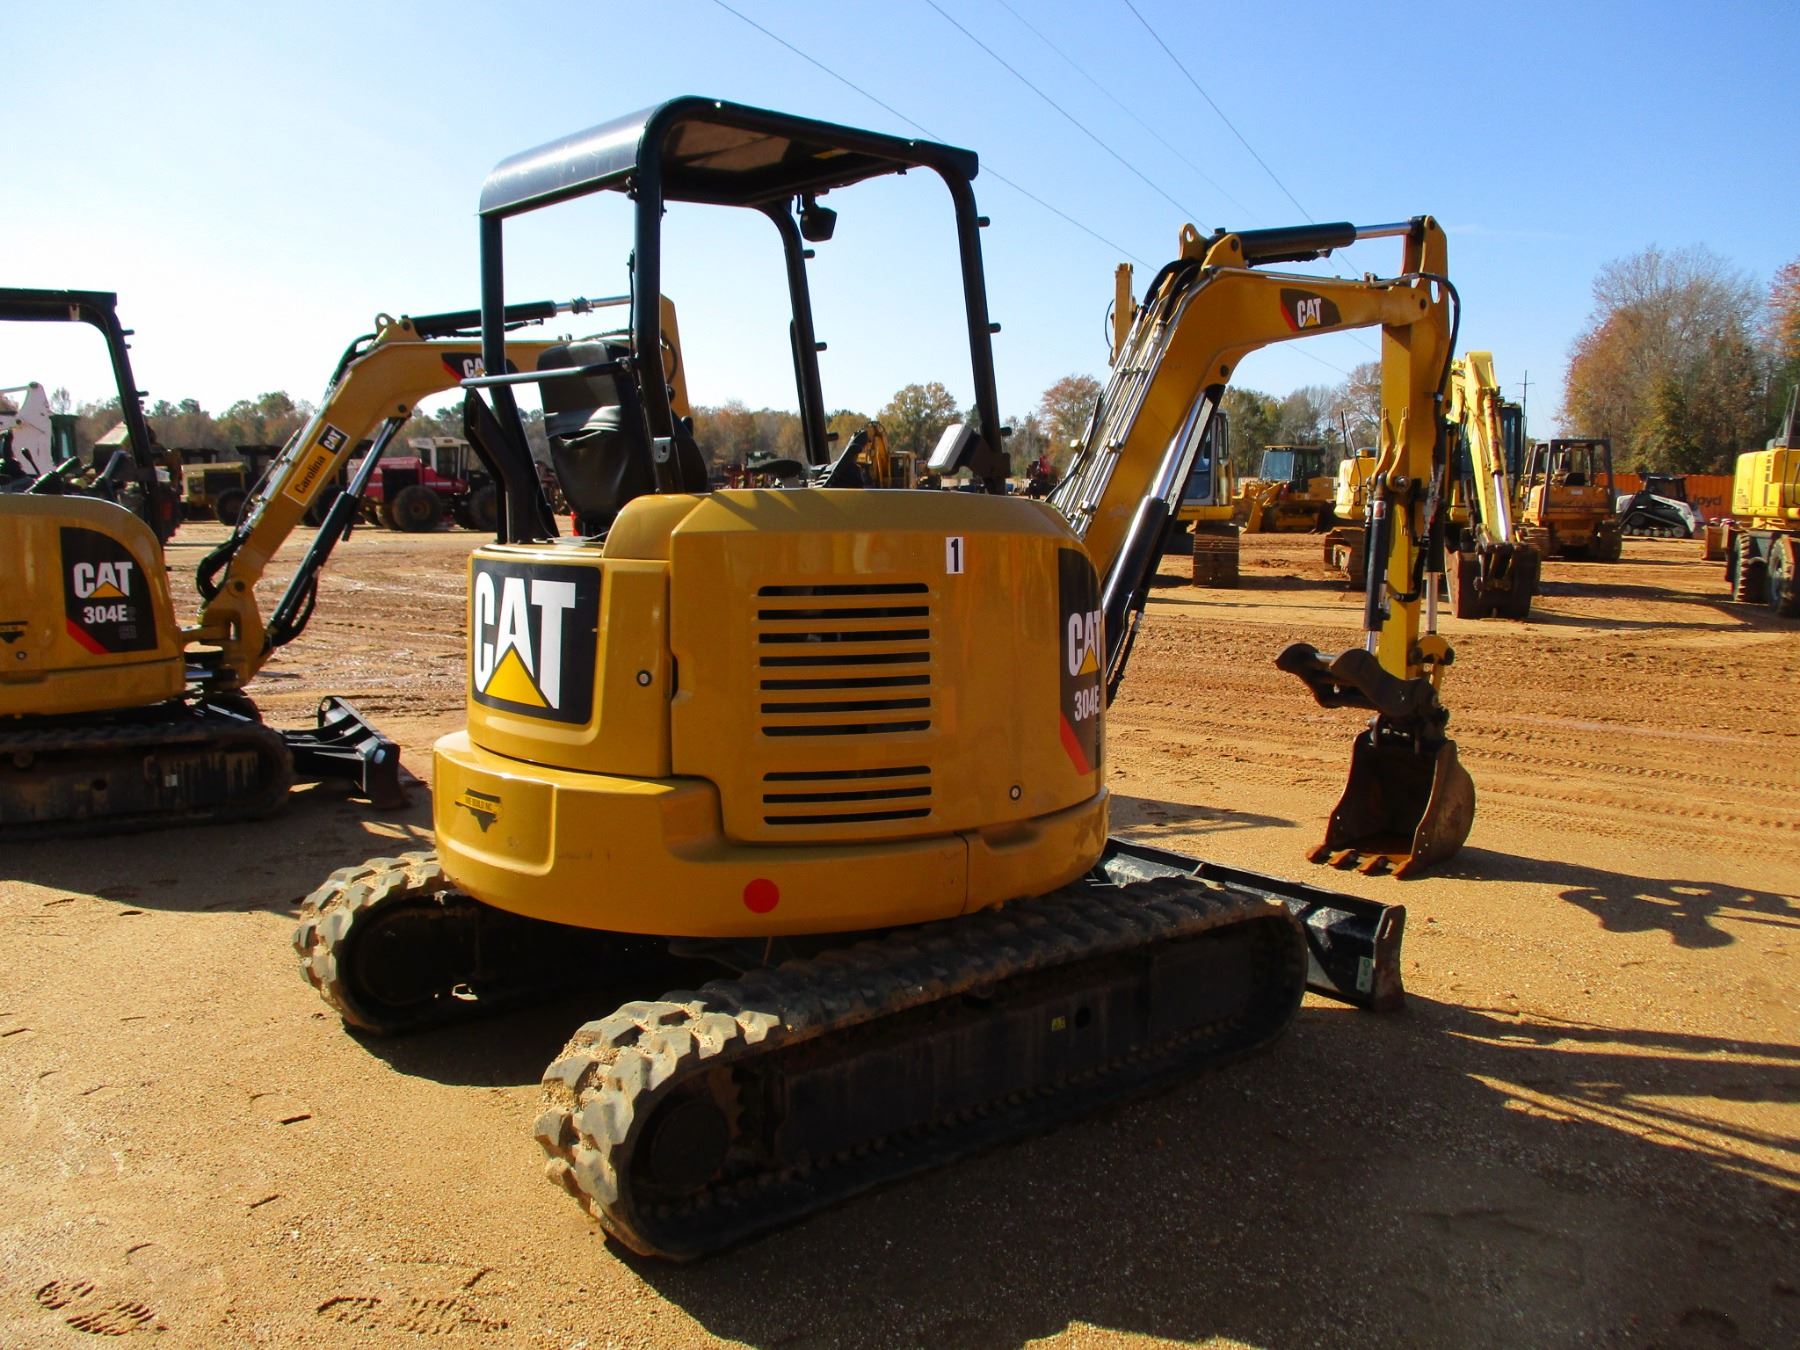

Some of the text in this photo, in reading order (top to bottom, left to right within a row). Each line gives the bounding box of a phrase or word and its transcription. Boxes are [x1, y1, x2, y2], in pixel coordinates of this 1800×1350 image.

[1296, 297, 1322, 328] CAT
[462, 357, 485, 378] CA
[294, 429, 342, 494] Carolina CAT
[951, 538, 959, 573] 1
[73, 561, 133, 599] CAT
[83, 604, 128, 624] 304E
[474, 570, 577, 710] CAT
[1068, 609, 1102, 677] CAT
[1074, 685, 1101, 722] 304E
